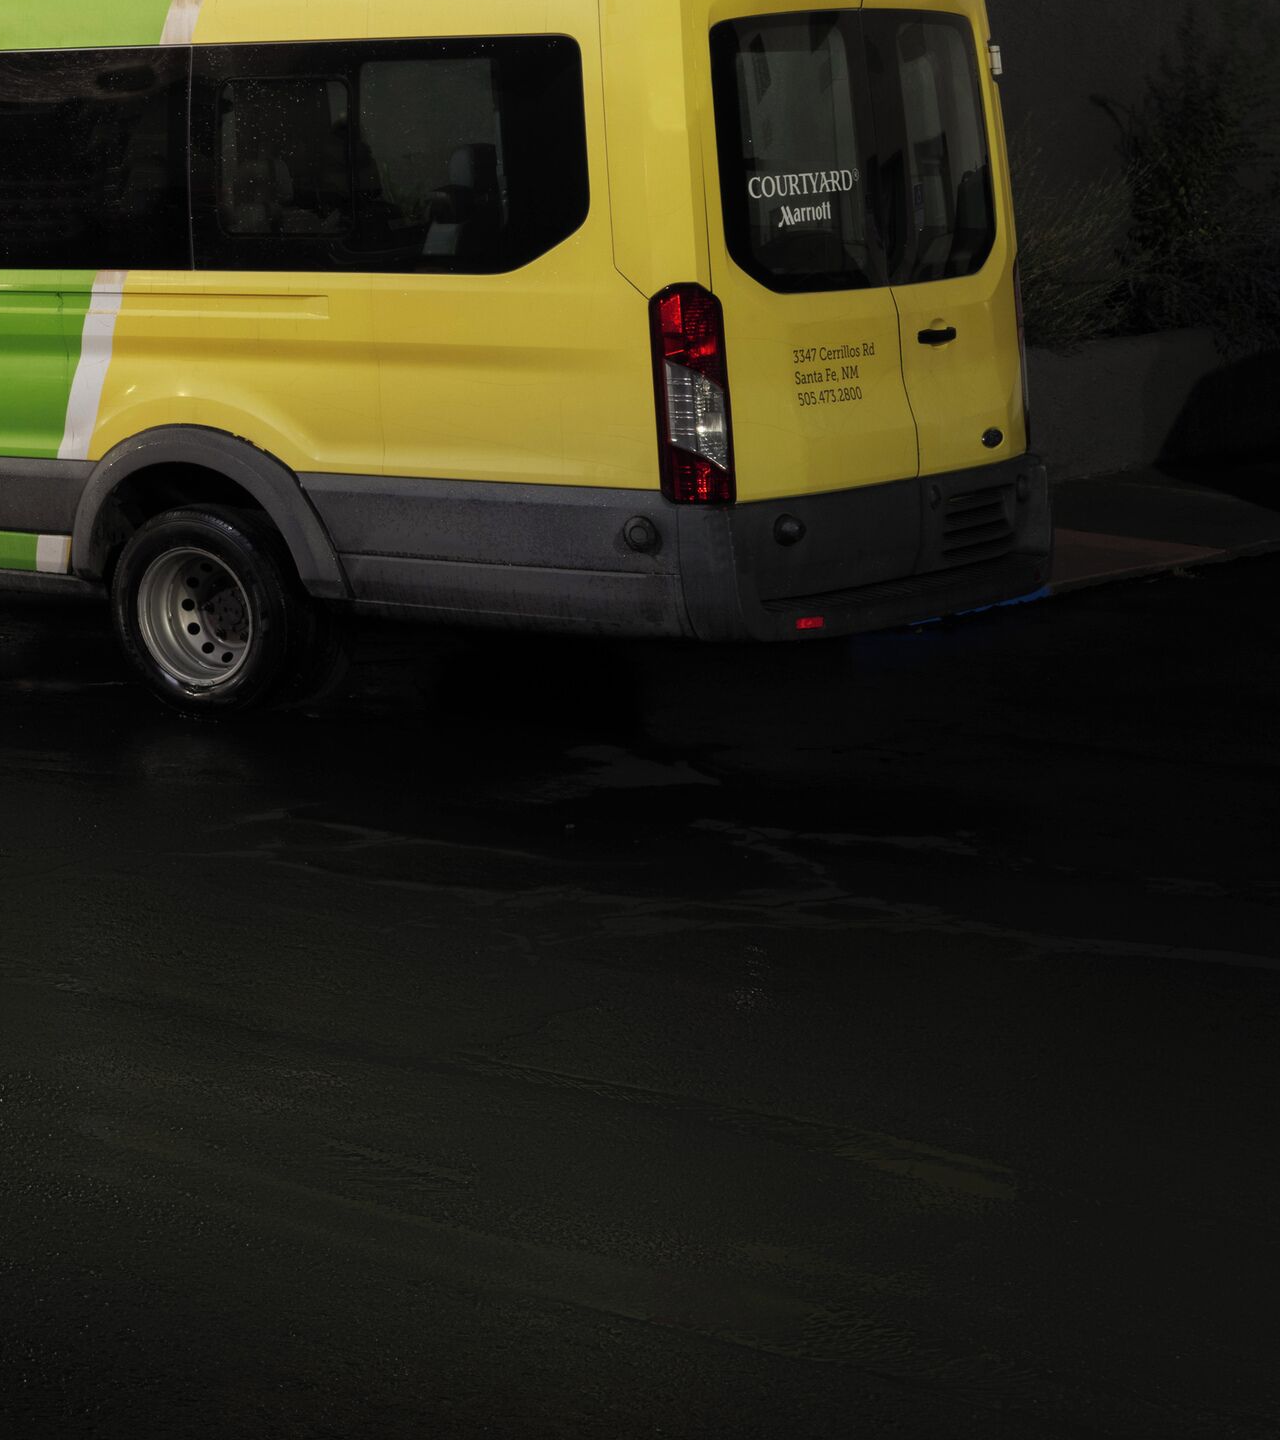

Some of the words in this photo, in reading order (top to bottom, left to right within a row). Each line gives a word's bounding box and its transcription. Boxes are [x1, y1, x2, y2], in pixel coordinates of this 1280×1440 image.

[778, 201, 832, 228] Marriott
[792, 348, 817, 364] 3347
[819, 344, 861, 361] Cerrillos
[862, 342, 876, 357] Rd
[794, 371, 824, 385] Santa
[825, 368, 840, 383] Fe,
[841, 365, 860, 380] NM
[797, 386, 863, 407] 505.473.2800
